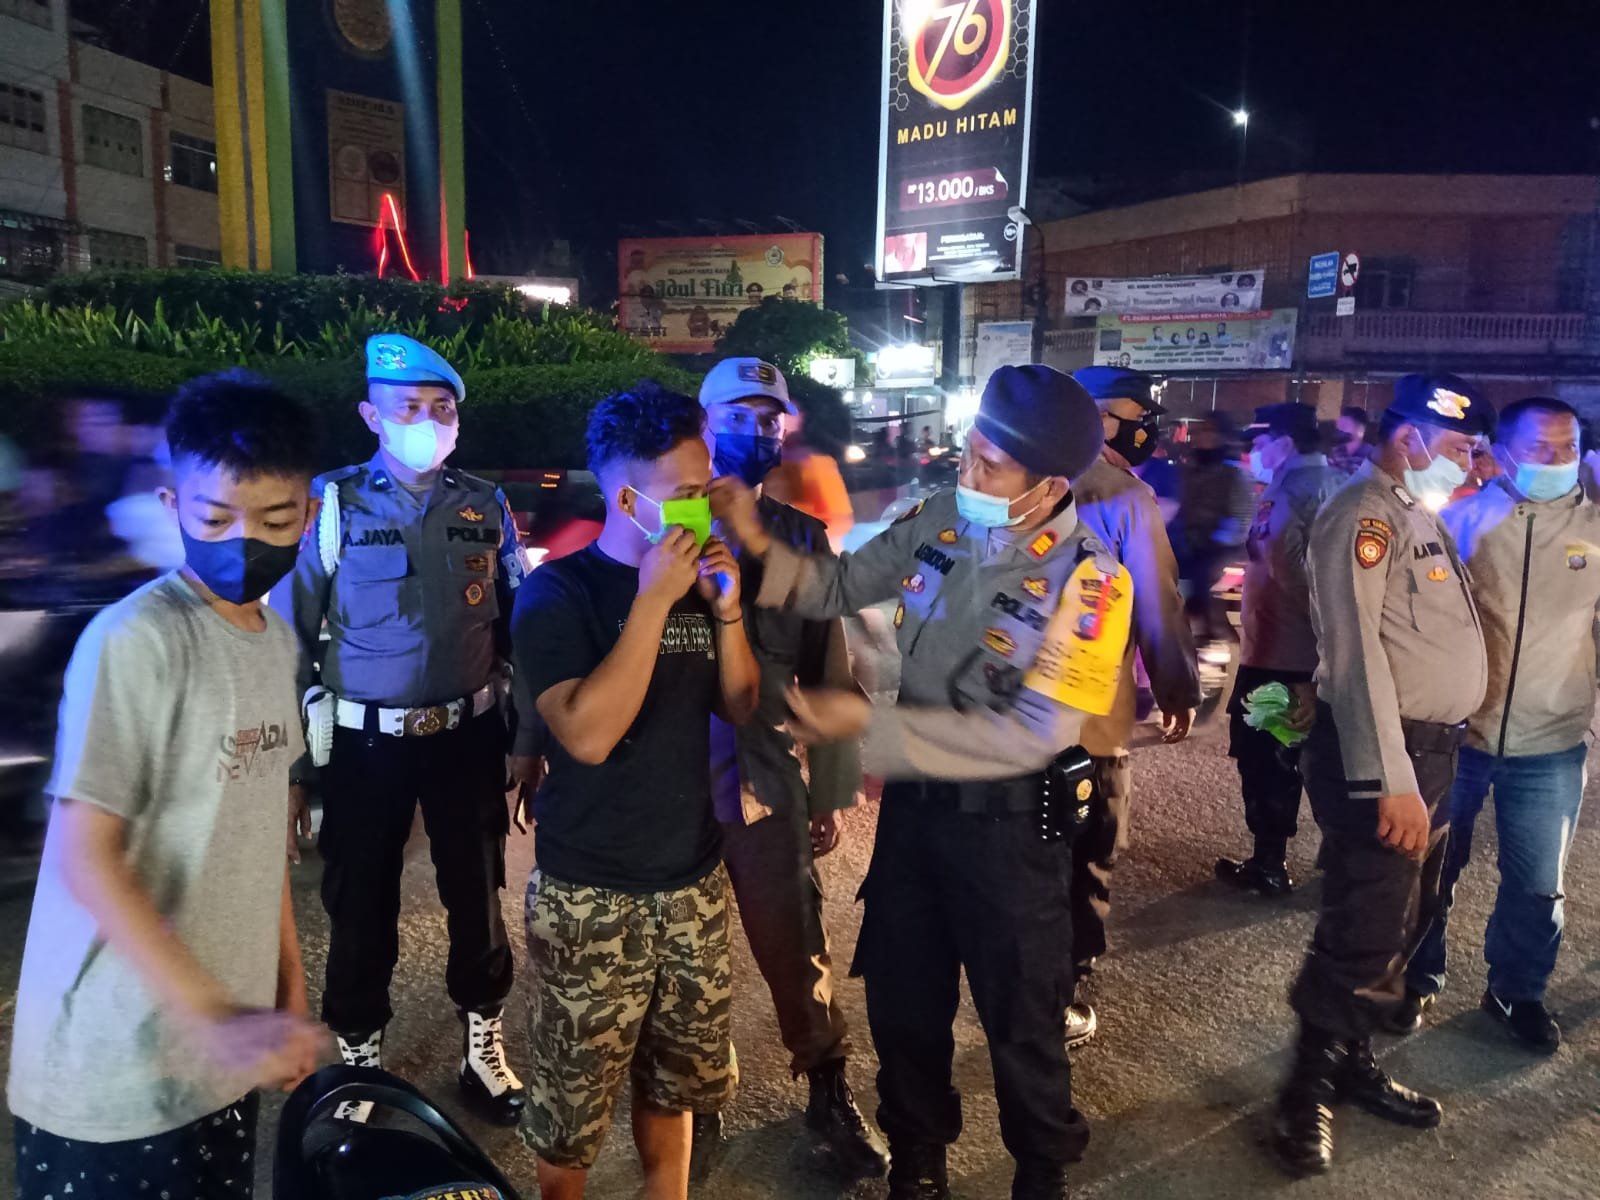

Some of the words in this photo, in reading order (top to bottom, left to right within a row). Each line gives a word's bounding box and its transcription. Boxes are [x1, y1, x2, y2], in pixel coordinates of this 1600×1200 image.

[924, 0, 987, 85] 76
[897, 120, 947, 144] MADU
[956, 108, 1017, 134] HITAM
[342, 528, 404, 547] A.JAYA
